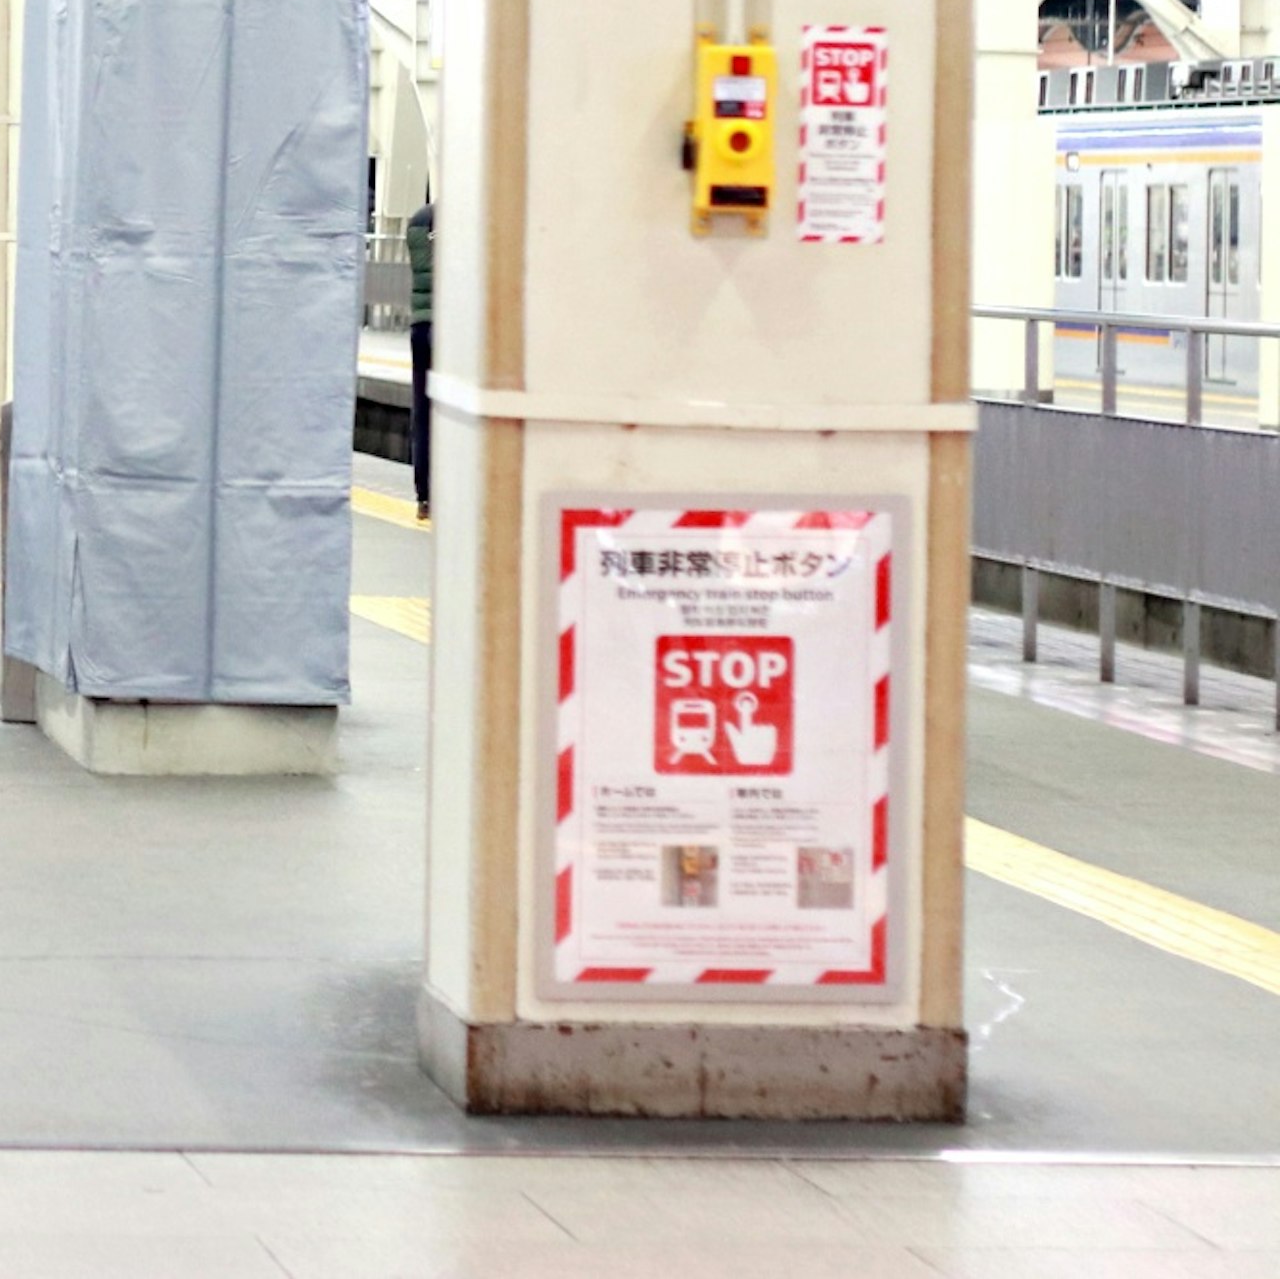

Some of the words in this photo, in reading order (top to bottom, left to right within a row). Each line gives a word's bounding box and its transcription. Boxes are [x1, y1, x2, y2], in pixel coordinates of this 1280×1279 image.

[815, 48, 874, 67] STOP
[745, 587, 779, 603] stop
[782, 587, 834, 601] button
[662, 650, 787, 689] STOP
